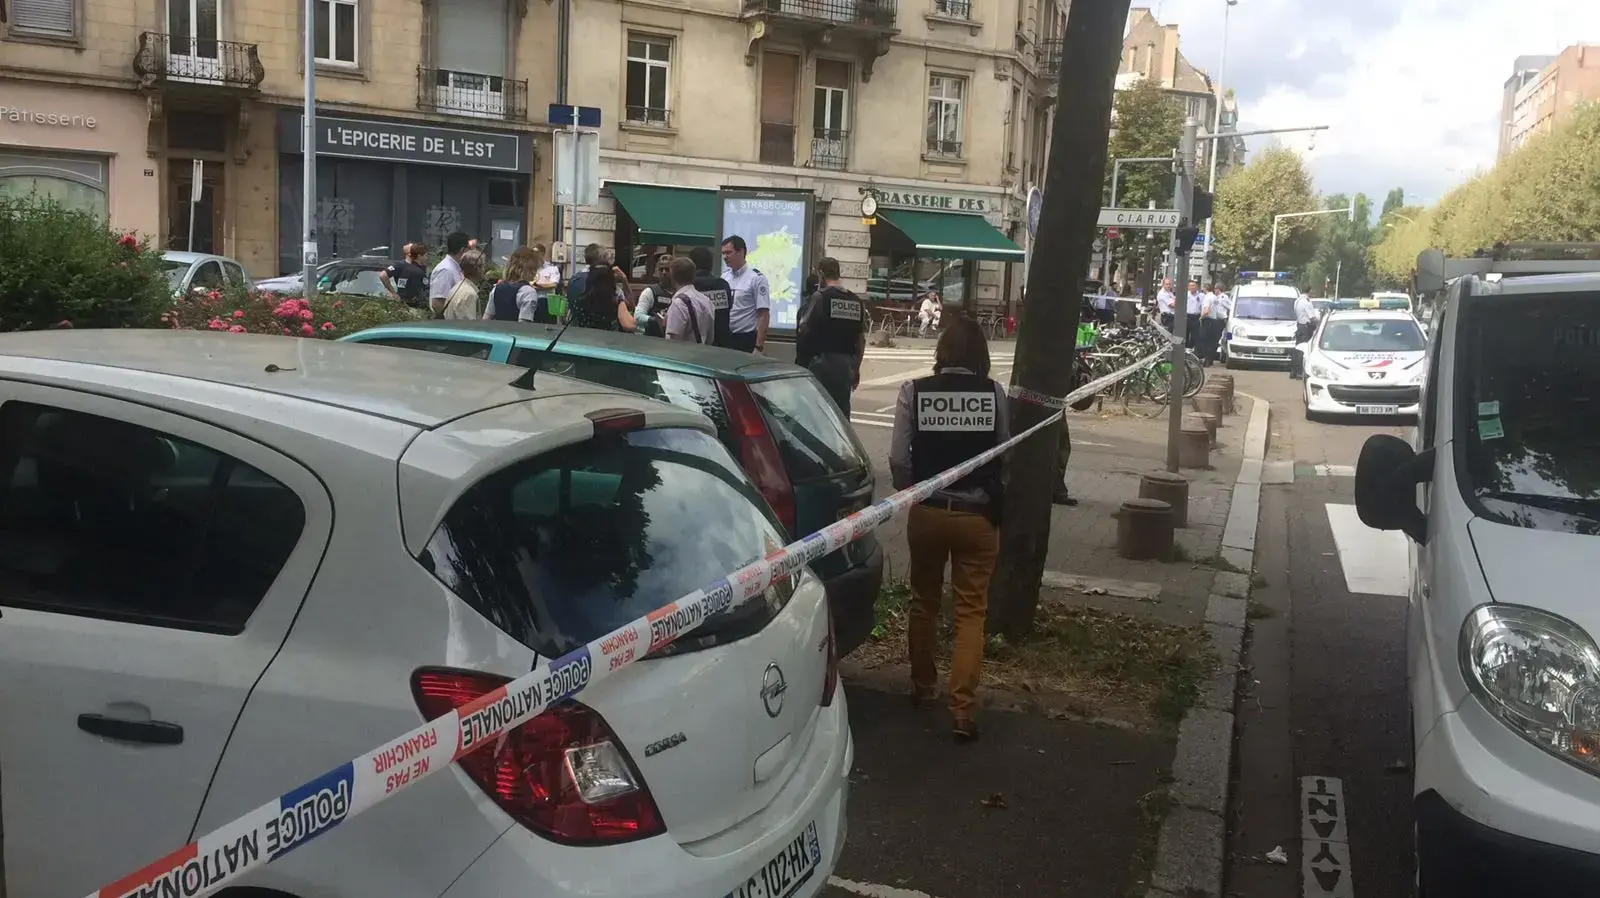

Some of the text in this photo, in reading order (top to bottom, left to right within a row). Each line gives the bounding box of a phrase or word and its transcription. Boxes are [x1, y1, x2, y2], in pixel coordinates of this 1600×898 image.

[0, 105, 96, 128] Pâtisserie
[327, 127, 495, 158] L'EPICERIE DE L'EST
[740, 200, 800, 211] STRASBOURG
[959, 198, 985, 210] DES
[704, 292, 727, 301] LICE
[832, 301, 860, 311] POLICE
[920, 397, 993, 413] POLICE
[921, 416, 993, 426] JUDICIAIRE
[701, 586, 732, 616] POLICE
[652, 600, 703, 645] NATIONALE
[600, 626, 639, 655] FRANCHIR
[608, 647, 635, 671] NE PAS
[462, 657, 589, 746] POLICE NATIONALE
[373, 727, 438, 774] FRANCHIR
[385, 756, 430, 794] NE PAS
[126, 780, 349, 898] POLICE NATIONA
[1307, 779, 1343, 898] AYANT
